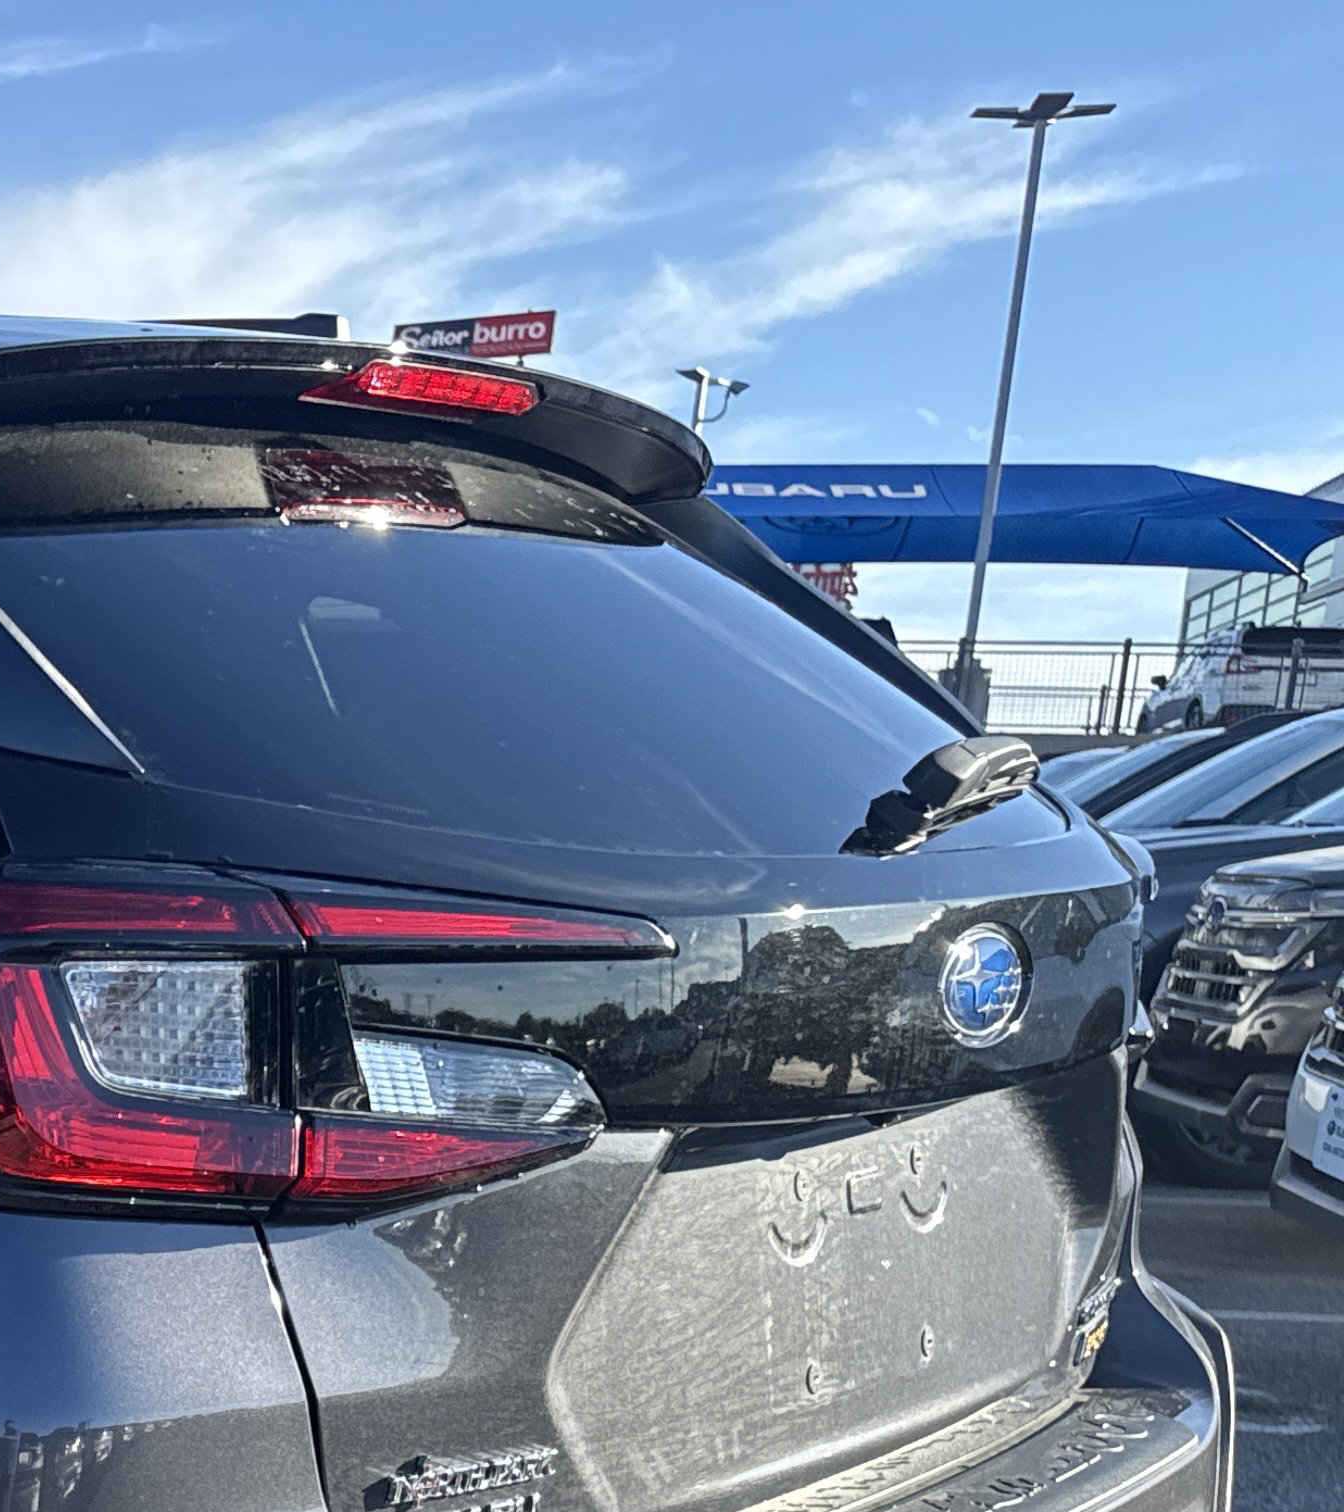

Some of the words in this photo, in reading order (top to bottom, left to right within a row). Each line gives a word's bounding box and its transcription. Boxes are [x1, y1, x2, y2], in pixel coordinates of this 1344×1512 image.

[400, 326, 470, 348] Señor
[473, 320, 547, 345] burro
[700, 482, 928, 499] UBARU
